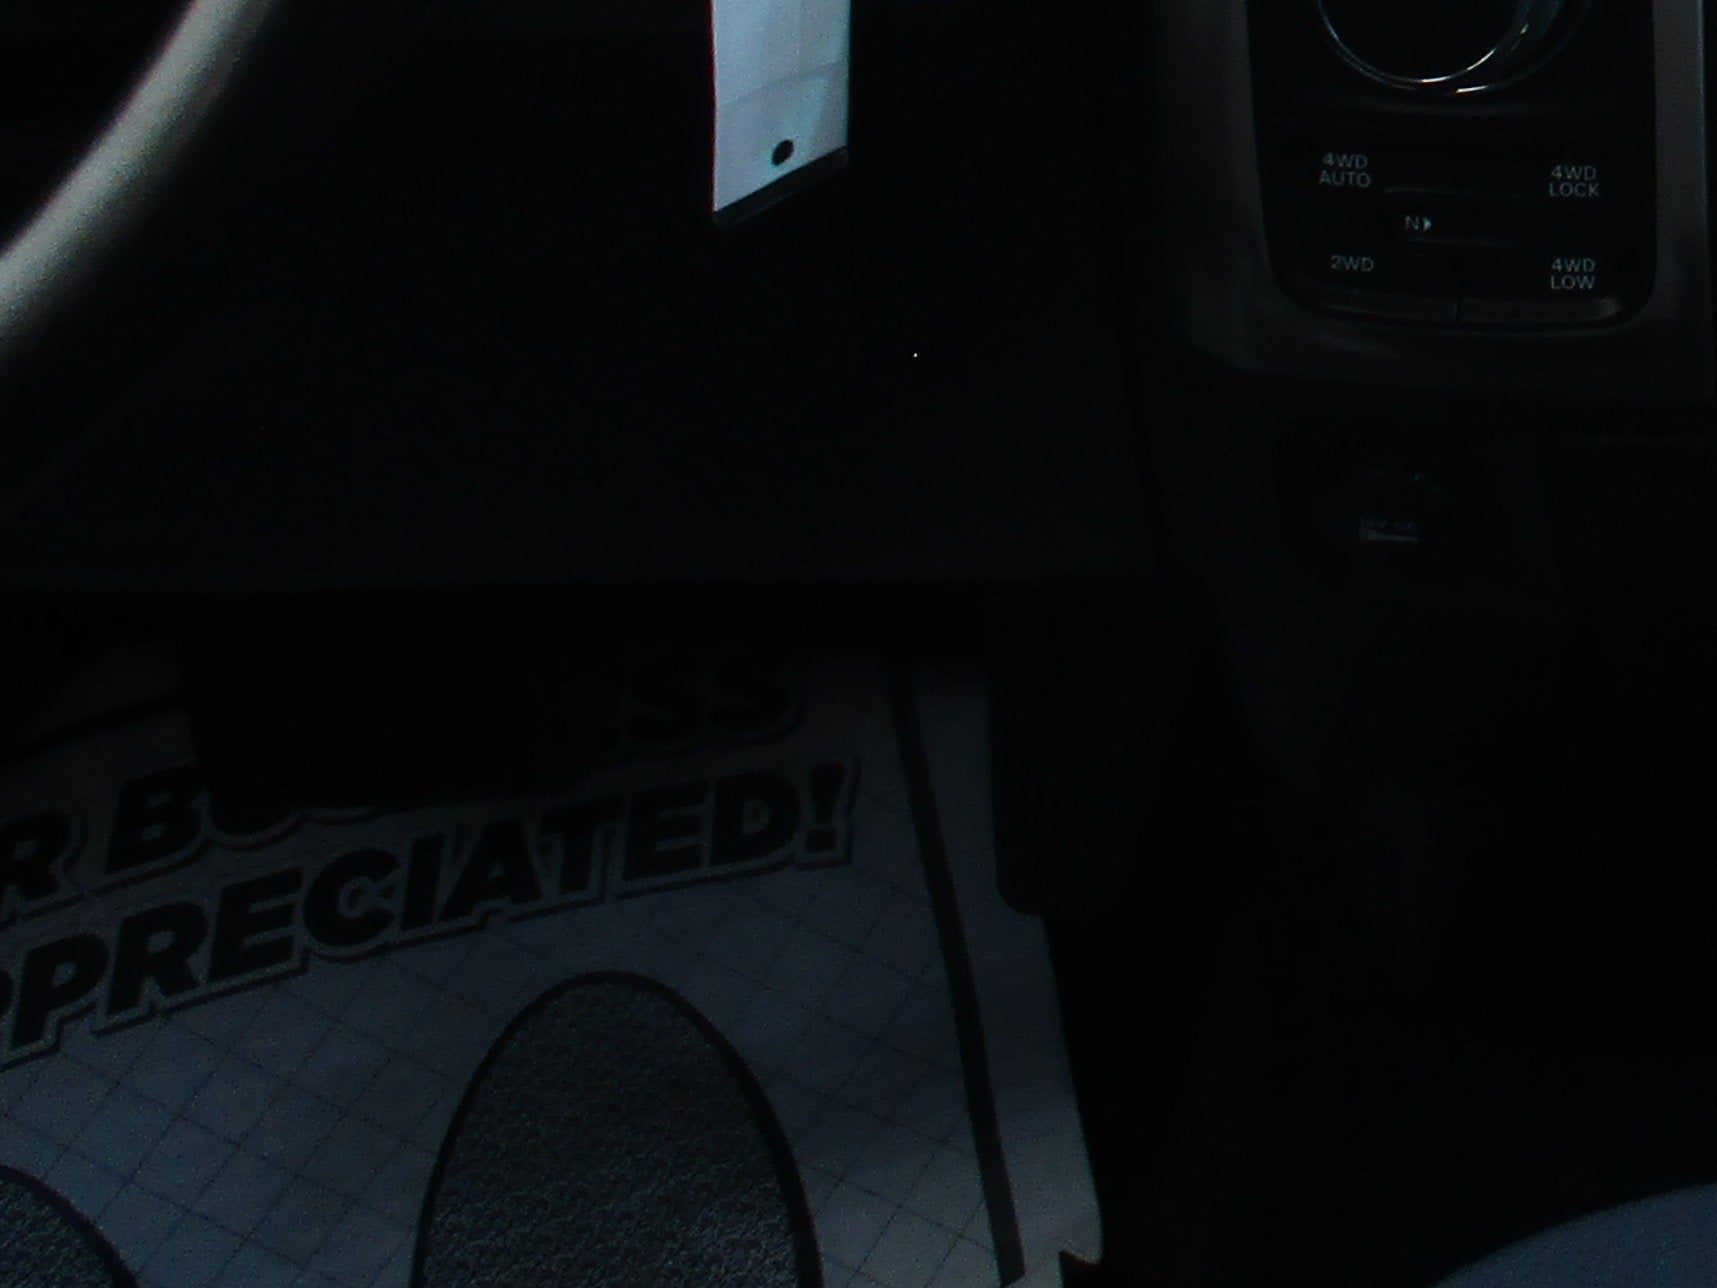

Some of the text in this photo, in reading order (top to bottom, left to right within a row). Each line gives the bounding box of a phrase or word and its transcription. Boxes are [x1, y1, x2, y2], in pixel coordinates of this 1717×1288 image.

[1322, 152, 1368, 170] 4WD
[1319, 171, 1371, 187] AUTO
[1550, 164, 1597, 185] 4WD
[1549, 183, 1599, 199] LOCK
[1330, 254, 1375, 272] 2WD
[1551, 257, 1596, 273] 4WD
[1550, 274, 1595, 290] LOW
[0, 762, 845, 1048] PRECIATED!
